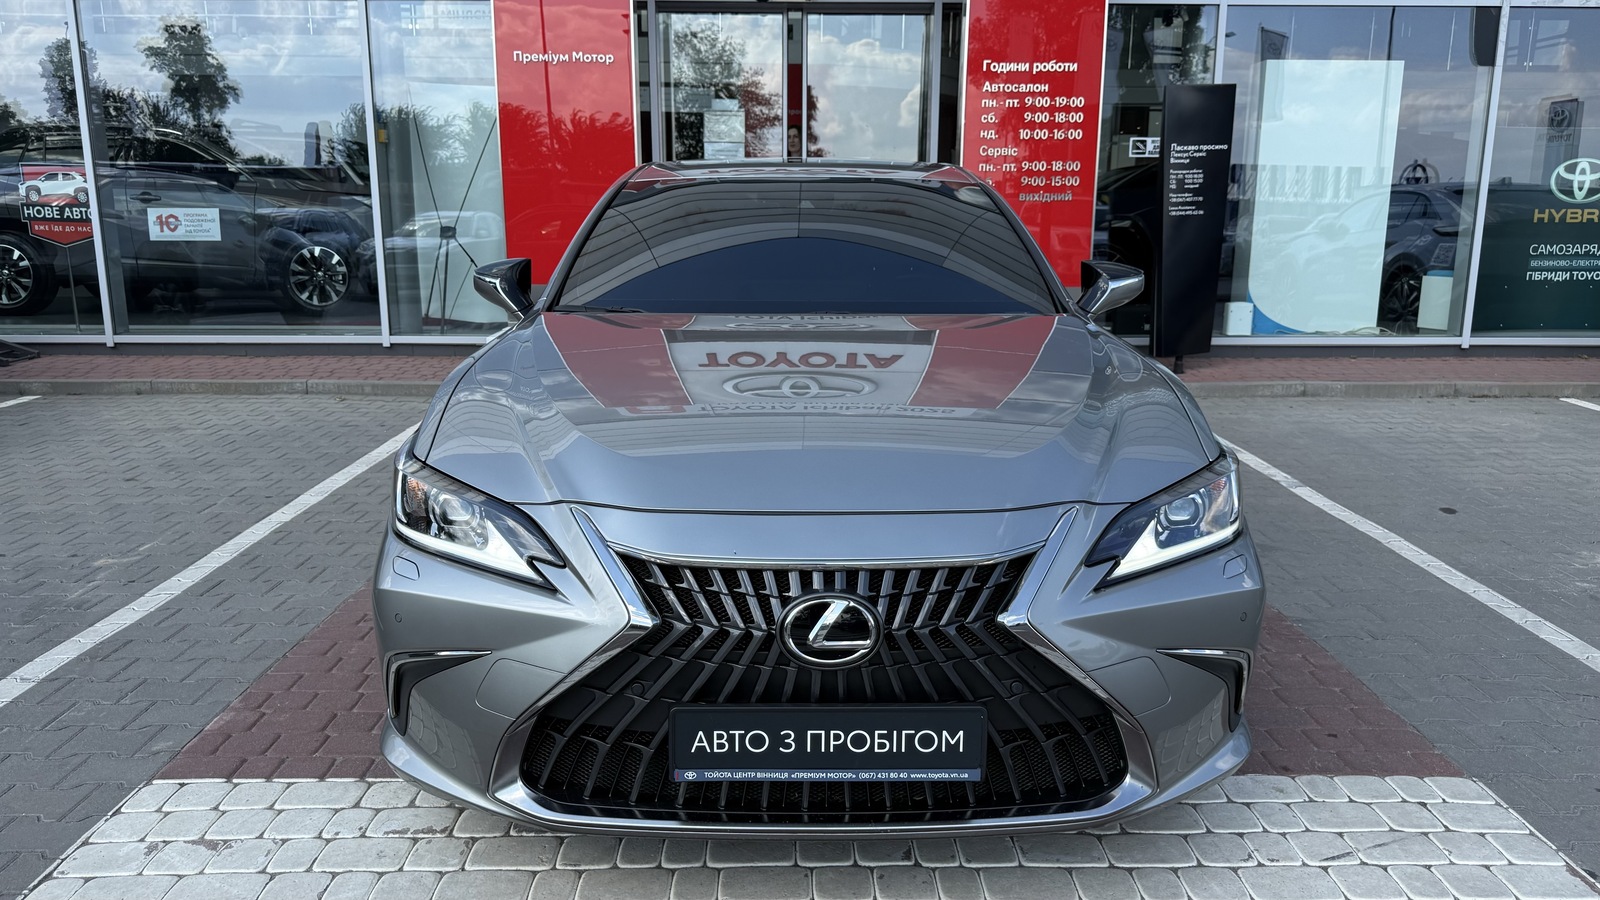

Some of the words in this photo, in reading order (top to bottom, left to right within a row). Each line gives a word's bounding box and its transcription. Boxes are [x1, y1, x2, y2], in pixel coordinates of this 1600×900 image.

[513, 50, 569, 64] Преміум
[572, 51, 615, 65] Мотор
[982, 59, 1030, 74] Години
[1032, 59, 1078, 75] роботи
[982, 81, 1049, 92] Автосалон
[1024, 96, 1085, 108] 9:00-19:00
[981, 112, 998, 123] сб.
[1023, 112, 1084, 123] 9:00-18:00
[980, 129, 998, 140] нд.
[1018, 128, 1083, 140] 10:00-16:00
[979, 145, 1018, 158] Сервіс
[1170, 143, 1199, 151] Ласкаво
[1021, 161, 1081, 172] 9:00-18:00
[1020, 176, 1080, 187] 9:00-15:00
[1019, 190, 1072, 203] вихідний
[23, 205, 61, 219] НОВЕ
[1533, 208, 1600, 223] HYBR
[1526, 271, 1571, 282] ГІБРИДИ
[691, 730, 770, 753] АВТО
[779, 730, 796, 753] З
[806, 730, 964, 753] ПРОБІГОМ
[704, 771, 732, 779] ТОЙОТА
[733, 772, 756, 780] ЦЕНТР
[756, 772, 789, 780] ВІННИЦЯ
[858, 772, 876, 780] (067)
[910, 772, 969, 780] www.toyota.vn.ua
